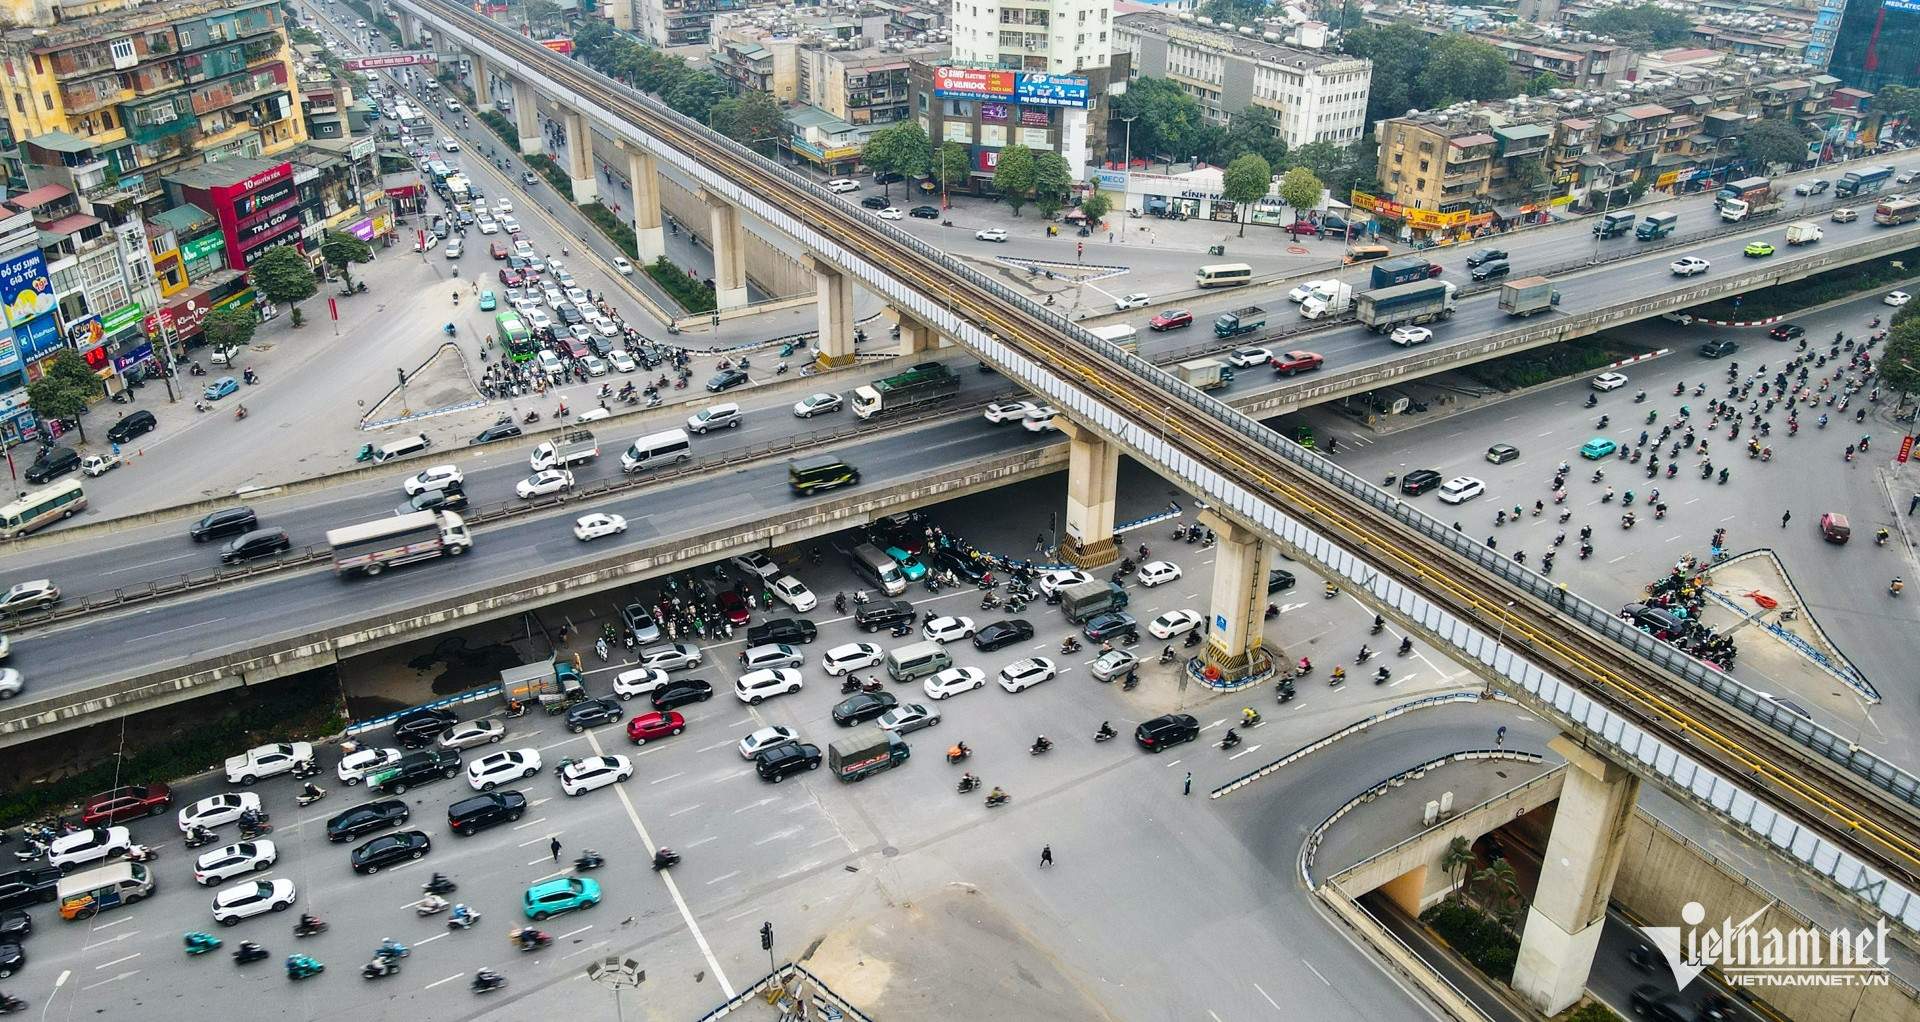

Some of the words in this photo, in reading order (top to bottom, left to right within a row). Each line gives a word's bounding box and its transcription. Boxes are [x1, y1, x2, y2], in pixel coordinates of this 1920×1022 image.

[243, 180, 253, 190] 10
[1181, 188, 1207, 199] KÍNH
[0, 263, 12, 278] ĐỒ
[12, 261, 22, 273] SƠ
[22, 256, 40, 269] SINH
[23, 266, 37, 280] TỐT
